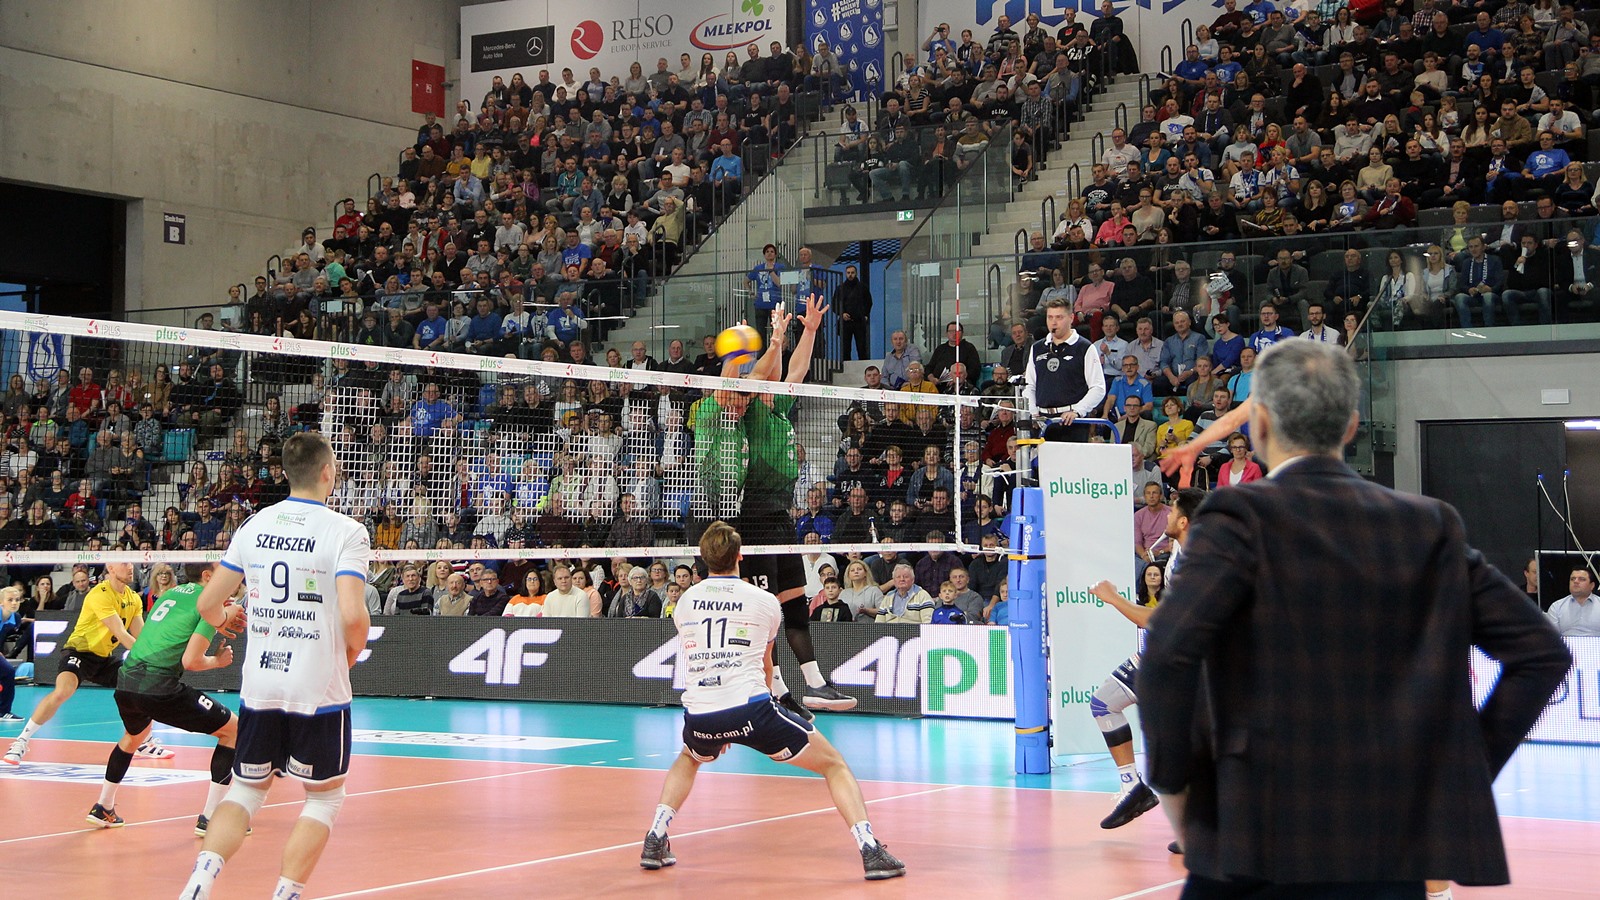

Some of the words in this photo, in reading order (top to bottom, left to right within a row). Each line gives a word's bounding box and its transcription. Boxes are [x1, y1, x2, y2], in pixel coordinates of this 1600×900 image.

[611, 14, 674, 41] RESO
[704, 19, 772, 38] MLEKPOL
[483, 42, 516, 52] Mercedes-Benz
[611, 43, 641, 53] EUROPA
[642, 39, 672, 49] SERVICE
[169, 226, 180, 242] B
[156, 327, 179, 342] plus
[331, 345, 350, 357] plus
[480, 357, 497, 370] plus
[609, 369, 624, 380] plus
[1049, 476, 1128, 499] plusliga.pl
[256, 533, 316, 553] SZERSZEŃ
[77, 553, 94, 562] plus
[205, 552, 221, 561] plus
[270, 560, 290, 604] 9
[752, 575, 769, 590] 13
[692, 600, 743, 611] TAKVAM
[1056, 586, 1131, 608] plusligl
[151, 599, 176, 622] 6
[277, 609, 316, 621] SUWAŁKI
[701, 617, 728, 649] 11
[67, 656, 82, 669] 21
[448, 628, 563, 685] 4F
[198, 694, 213, 710] 6
[693, 721, 755, 740] reso.com.pl
